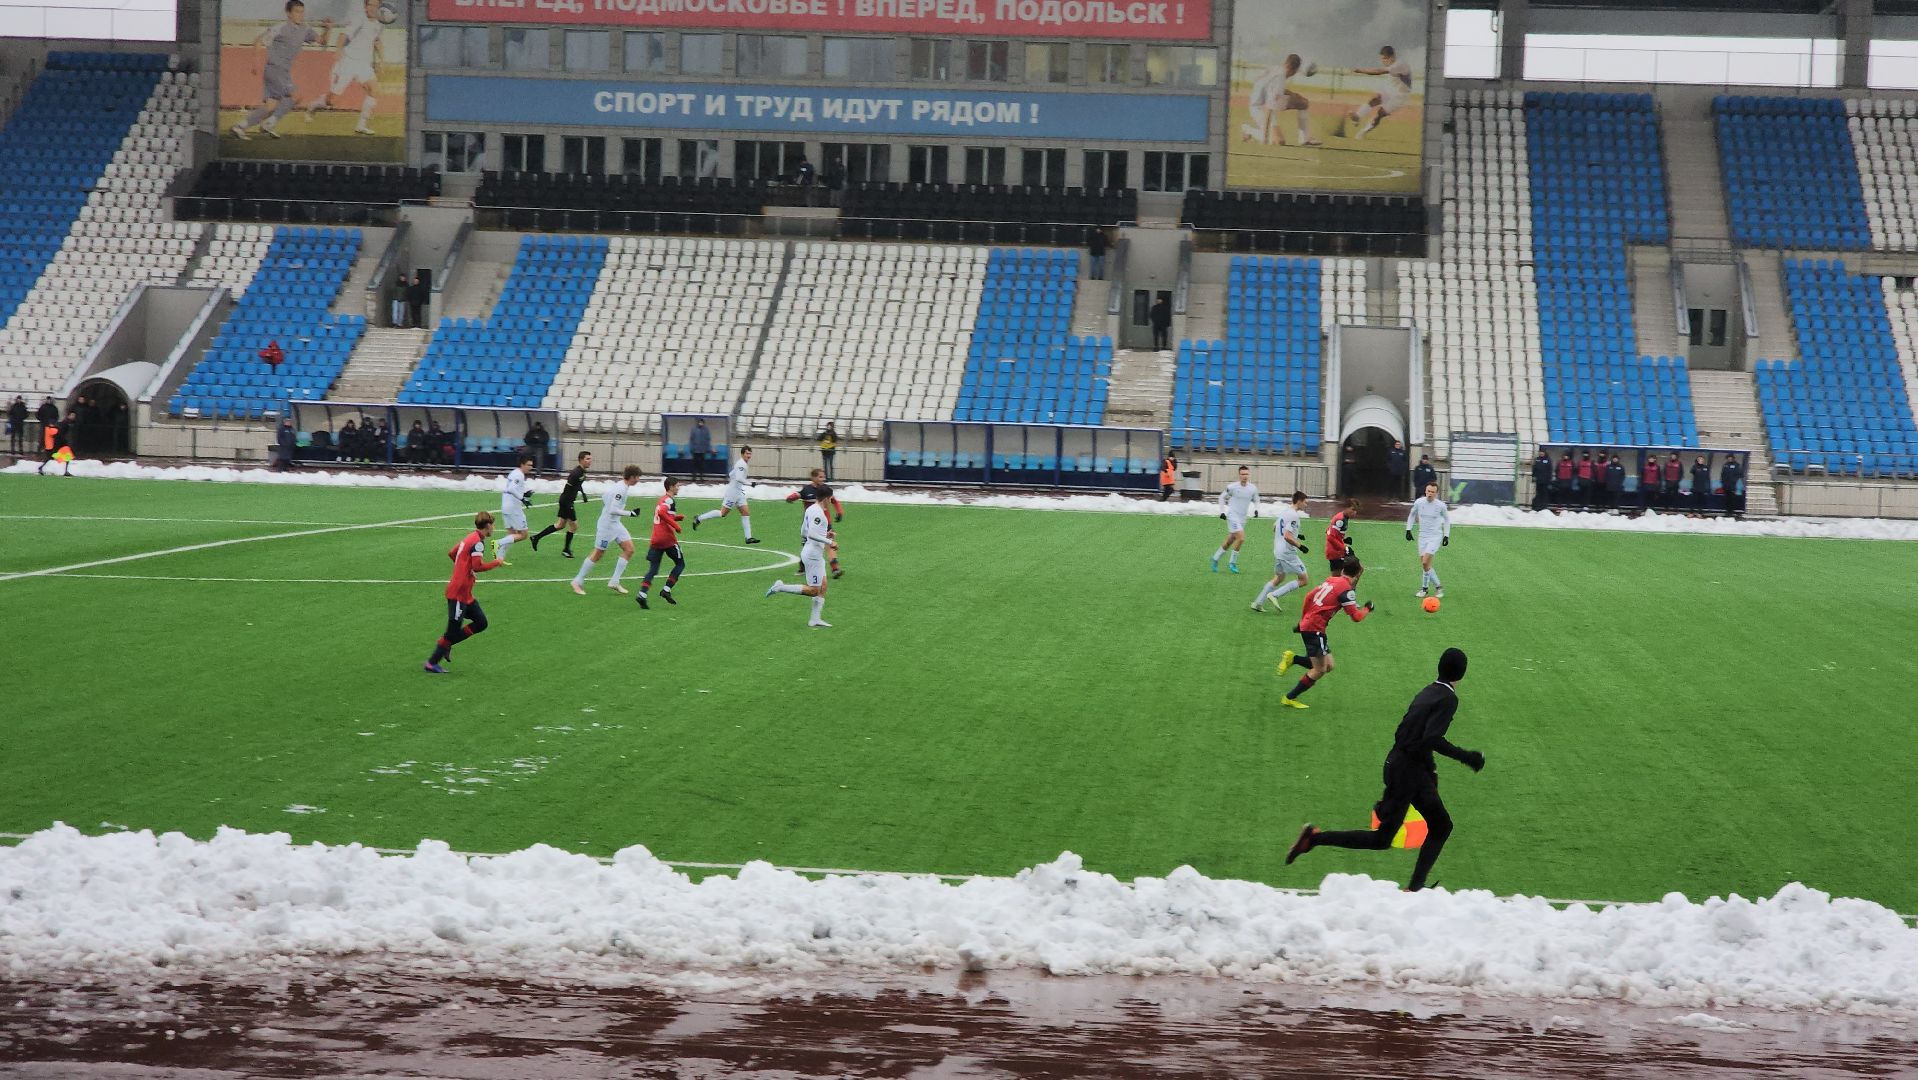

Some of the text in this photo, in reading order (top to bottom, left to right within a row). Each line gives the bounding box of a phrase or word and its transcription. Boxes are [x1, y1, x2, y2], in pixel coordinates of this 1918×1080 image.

[855, 0, 986, 24] ВПЕРЕД,
[995, 0, 1168, 25] ПОДОЛЬСК
[1176, 4, 1185, 24] !
[594, 91, 1039, 126] СПОРТ И ТРУД ИДУТ РЯДОМ !
[812, 575, 818, 584] 3
